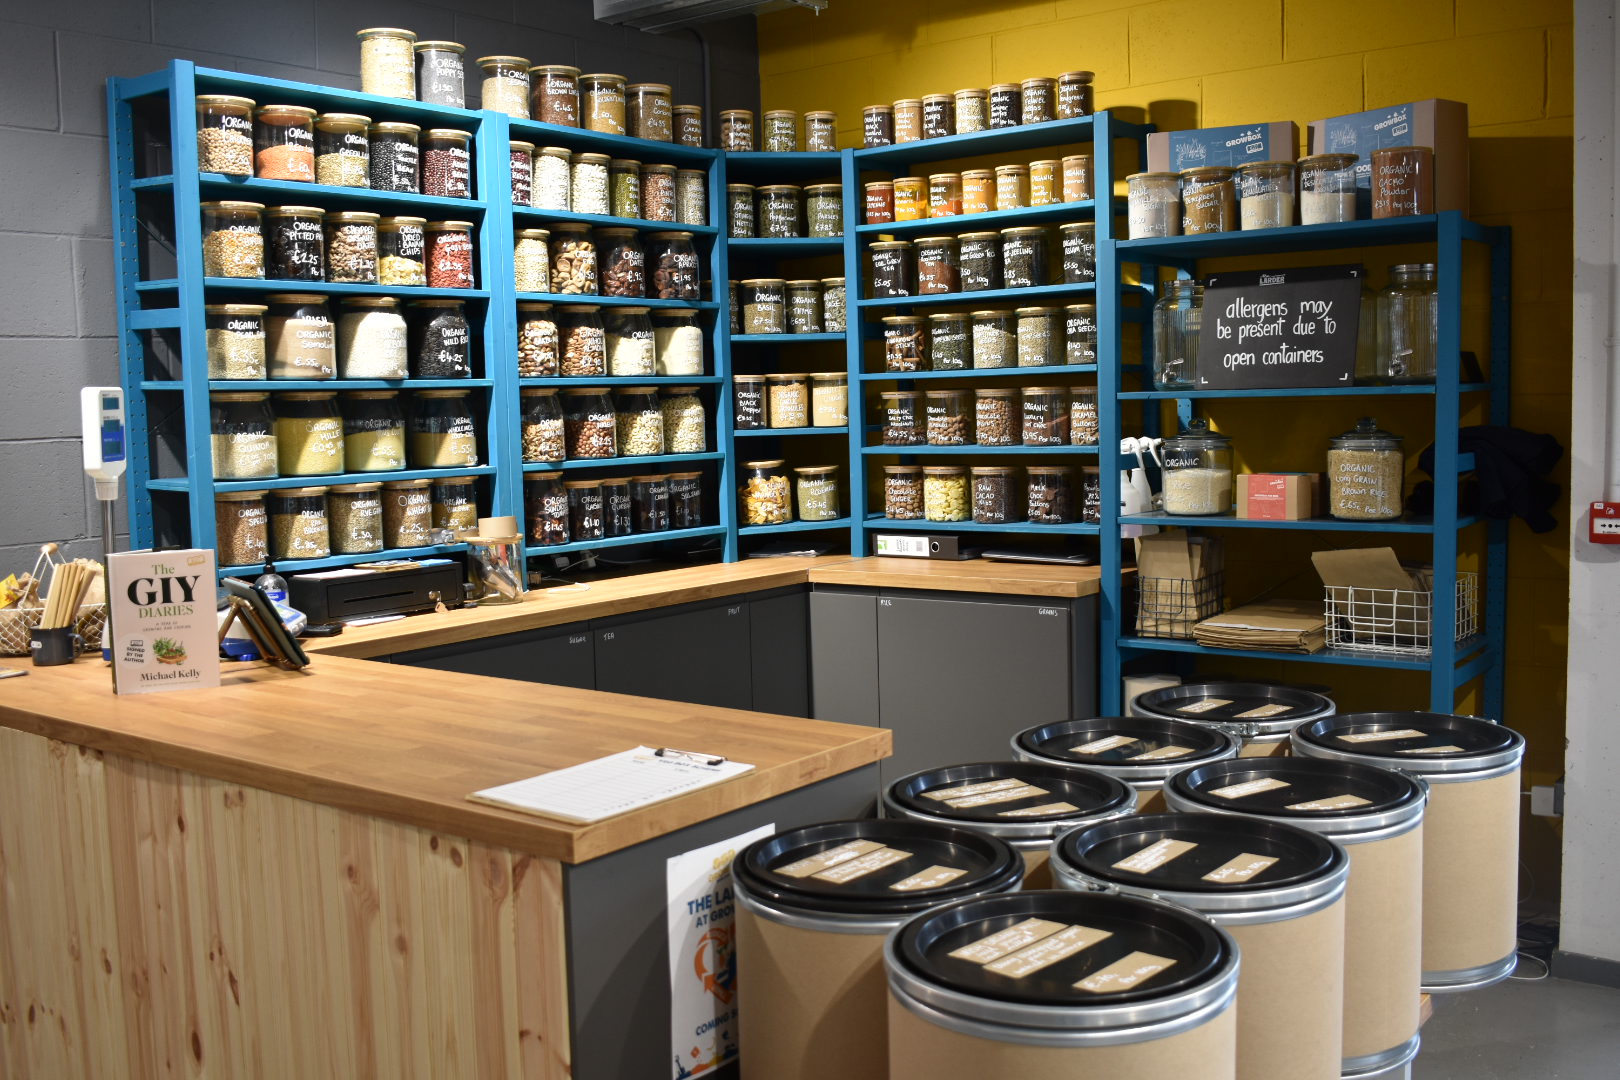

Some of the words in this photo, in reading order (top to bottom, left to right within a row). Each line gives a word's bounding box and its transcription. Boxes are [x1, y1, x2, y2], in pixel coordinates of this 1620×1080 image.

[1374, 114, 1407, 131] GROWBOX
[1225, 133, 1263, 147] GROWBOX
[1063, 168, 1086, 178] ORGANIC
[1301, 168, 1327, 181] ORGANIC
[1379, 164, 1414, 176] ORGANIC
[1031, 174, 1055, 183] ORGANIC
[769, 202, 795, 210] ORGANIC
[289, 231, 315, 241] PITTED
[920, 248, 944, 256] ORGANIC
[960, 243, 981, 253] ORGANIC
[1082, 243, 1095, 251] TEA
[883, 265, 895, 273] TEA
[1083, 268, 1095, 278] 100g
[976, 275, 989, 287] 100g
[1259, 276, 1285, 286] LARDER
[937, 282, 949, 292] 100g
[755, 293, 782, 302] ORGANIC
[757, 304, 776, 312] BASIL
[1226, 297, 1288, 323] allergens
[1300, 300, 1333, 320] may
[227, 320, 259, 331] ORGANIC
[1066, 317, 1092, 328] ORGANIC
[1077, 325, 1097, 333] SEEDS
[1217, 318, 1232, 340] be
[1238, 317, 1286, 345] present
[1292, 315, 1316, 336] due
[1323, 315, 1337, 335] to
[1032, 354, 1044, 364] 100g
[1083, 350, 1095, 359] 100g
[1223, 352, 1255, 372] open
[1262, 342, 1325, 366] containers
[738, 391, 761, 399] ORGANIC
[887, 407, 909, 415] ORGANIC
[926, 406, 946, 414] ORGANIC
[1023, 402, 1048, 412] ORGANIC
[1071, 401, 1094, 411] ORGANIC
[1071, 410, 1097, 420] CARAMEL
[938, 434, 949, 442] Per
[950, 434, 964, 445] 100g
[1038, 434, 1048, 443] Per
[1049, 434, 1062, 444] 100g
[1165, 457, 1199, 468] ORGANIC
[1340, 463, 1376, 474] ORGANIC
[887, 478, 912, 486] ORGANIC
[1353, 474, 1379, 486] GRAIN
[888, 487, 916, 495] Chocolate
[978, 484, 992, 492] RAW
[1341, 486, 1366, 497] BROWN
[975, 491, 995, 500] CACAO
[152, 564, 175, 575] The
[127, 575, 201, 606] GIY
[139, 605, 194, 619] DIARIES
[1038, 608, 1059, 617] GRAINS
[139, 671, 177, 683] Michael
[178, 668, 201, 680] Kelly
[687, 895, 712, 915] THE
[696, 914, 709, 929] AT
[696, 1012, 730, 1036] COMING
